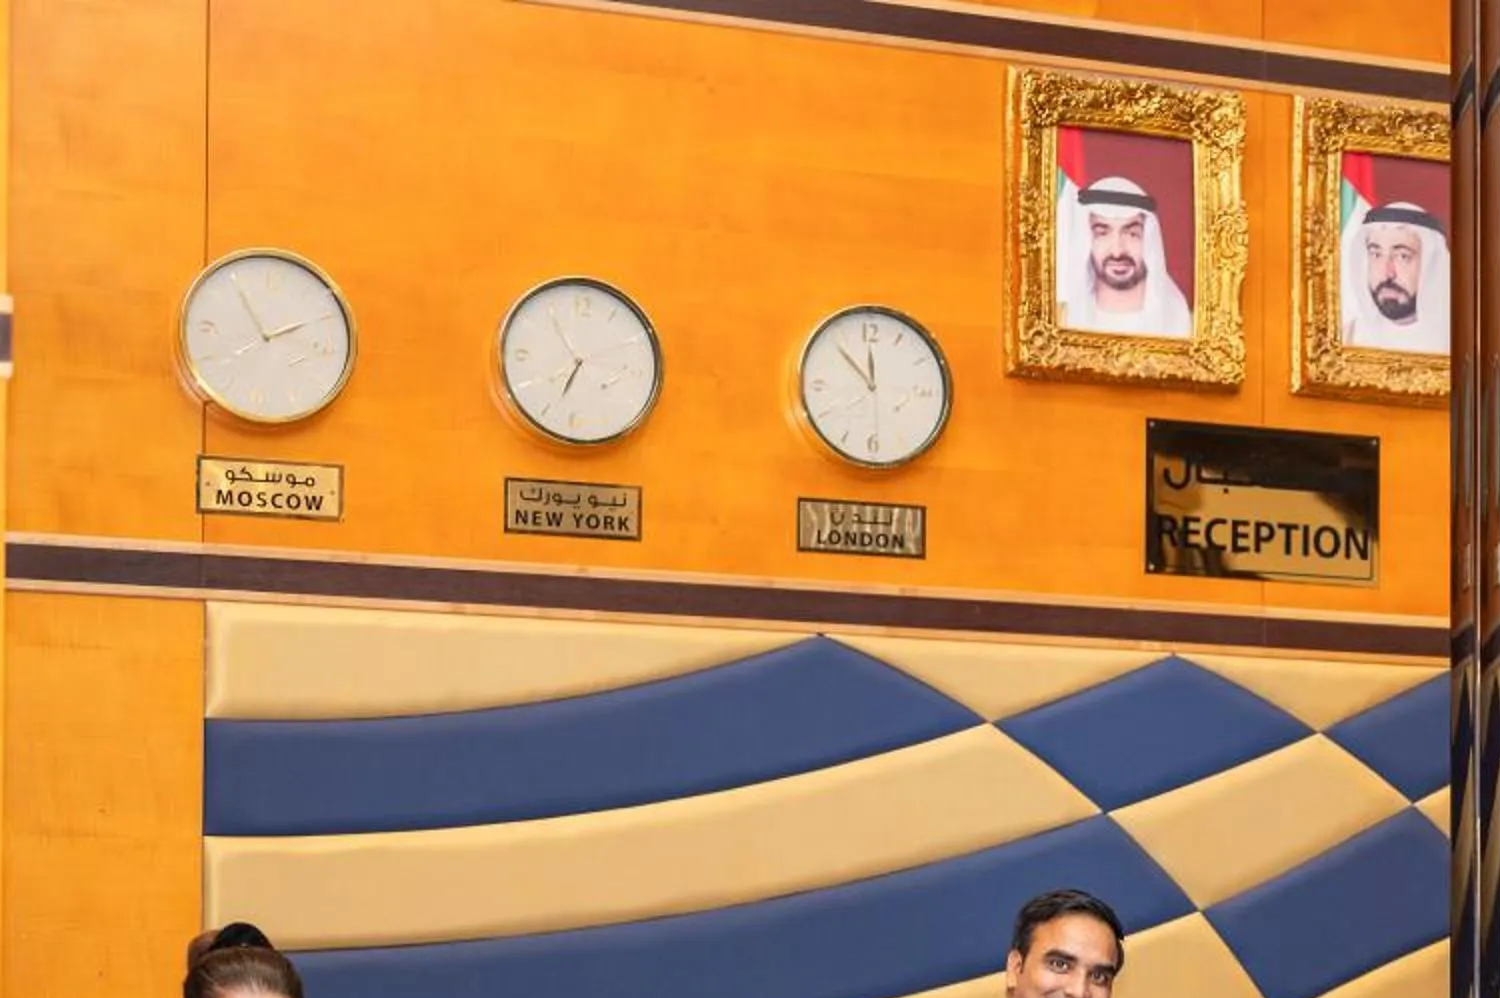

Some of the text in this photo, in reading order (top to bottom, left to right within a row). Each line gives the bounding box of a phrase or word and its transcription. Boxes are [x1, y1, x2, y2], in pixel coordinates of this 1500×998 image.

[861, 322, 880, 343] 12
[225, 465, 316, 488] موسكو
[215, 488, 324, 511] MOSCOW
[587, 491, 627, 511] نيو
[514, 509, 630, 531] NEW YORK
[816, 529, 905, 549] LONDON
[1157, 512, 1369, 561] RECEPTION
